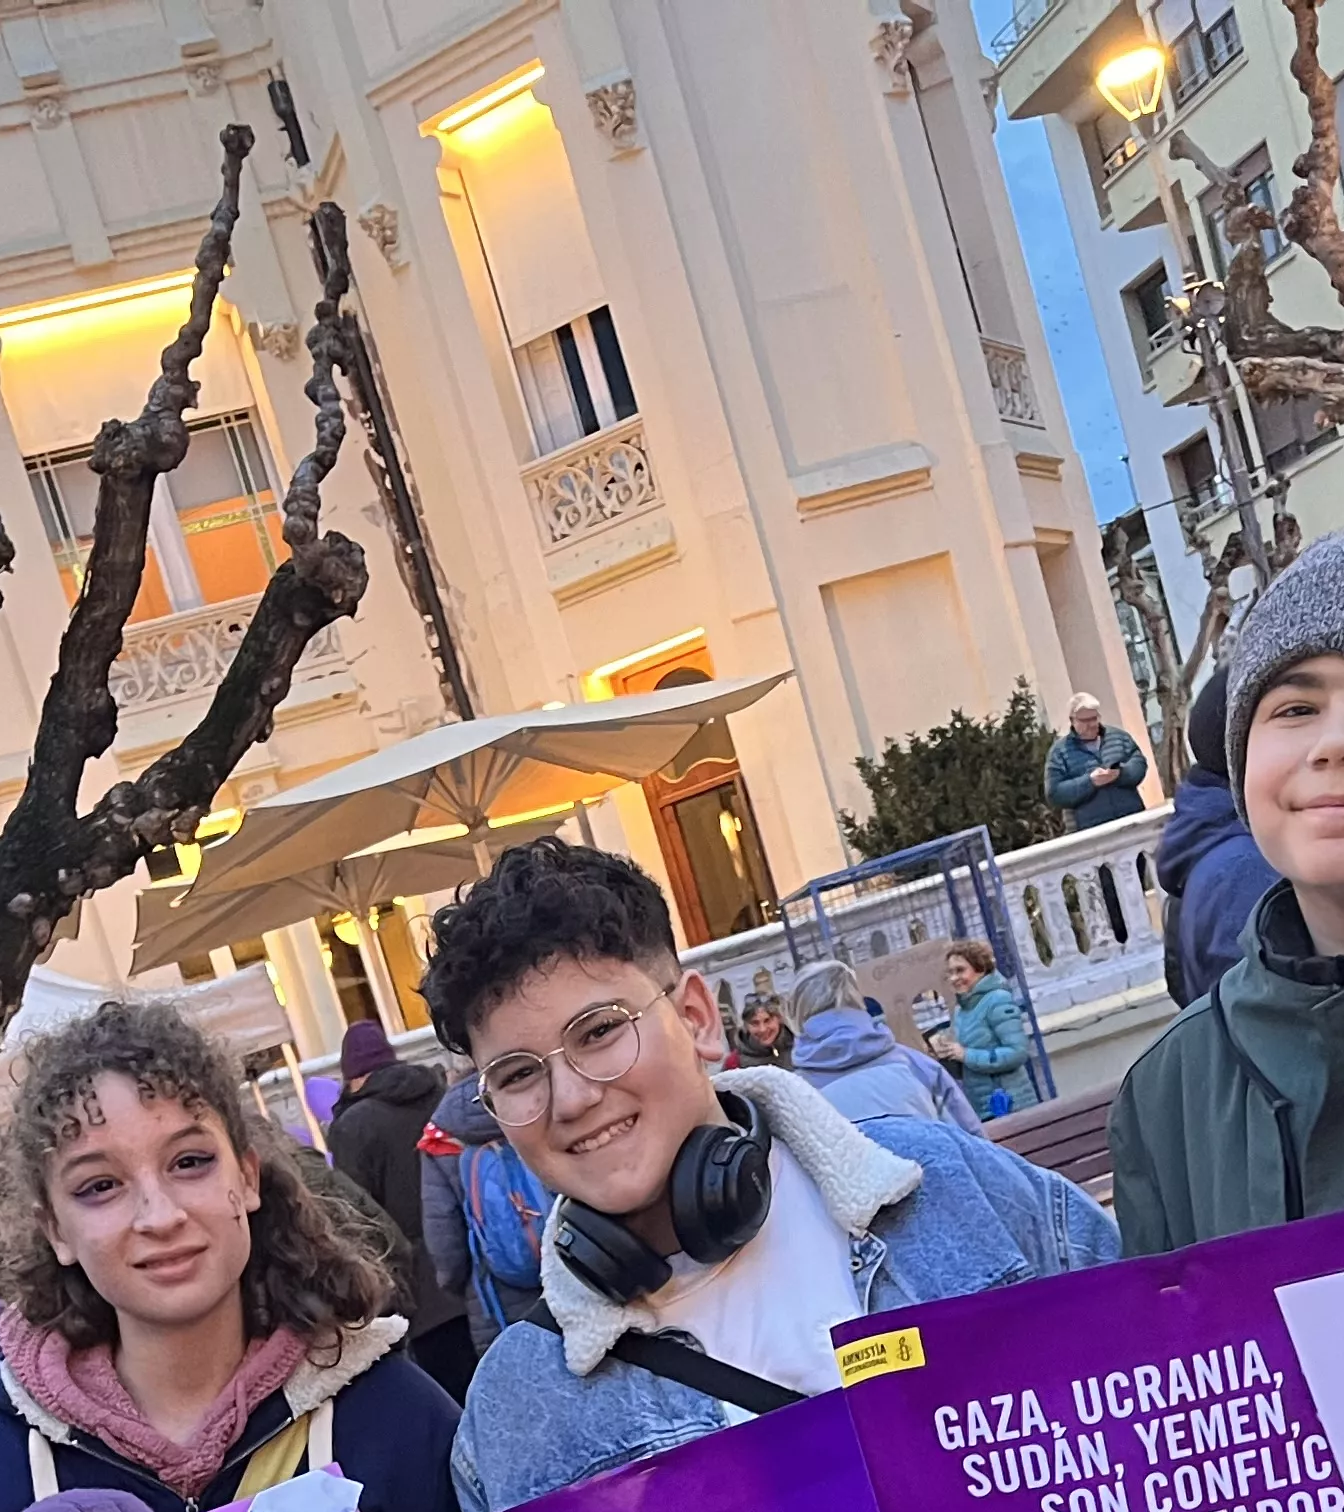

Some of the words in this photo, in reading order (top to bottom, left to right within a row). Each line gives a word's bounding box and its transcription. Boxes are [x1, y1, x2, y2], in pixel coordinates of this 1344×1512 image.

[842, 1342, 887, 1368] AMNISTÍA
[934, 1389, 1060, 1452] GAZA,
[1071, 1340, 1284, 1427] UCRANIA,
[963, 1424, 1124, 1499] SUDÁN,
[1134, 1390, 1300, 1467] YEMEN,
